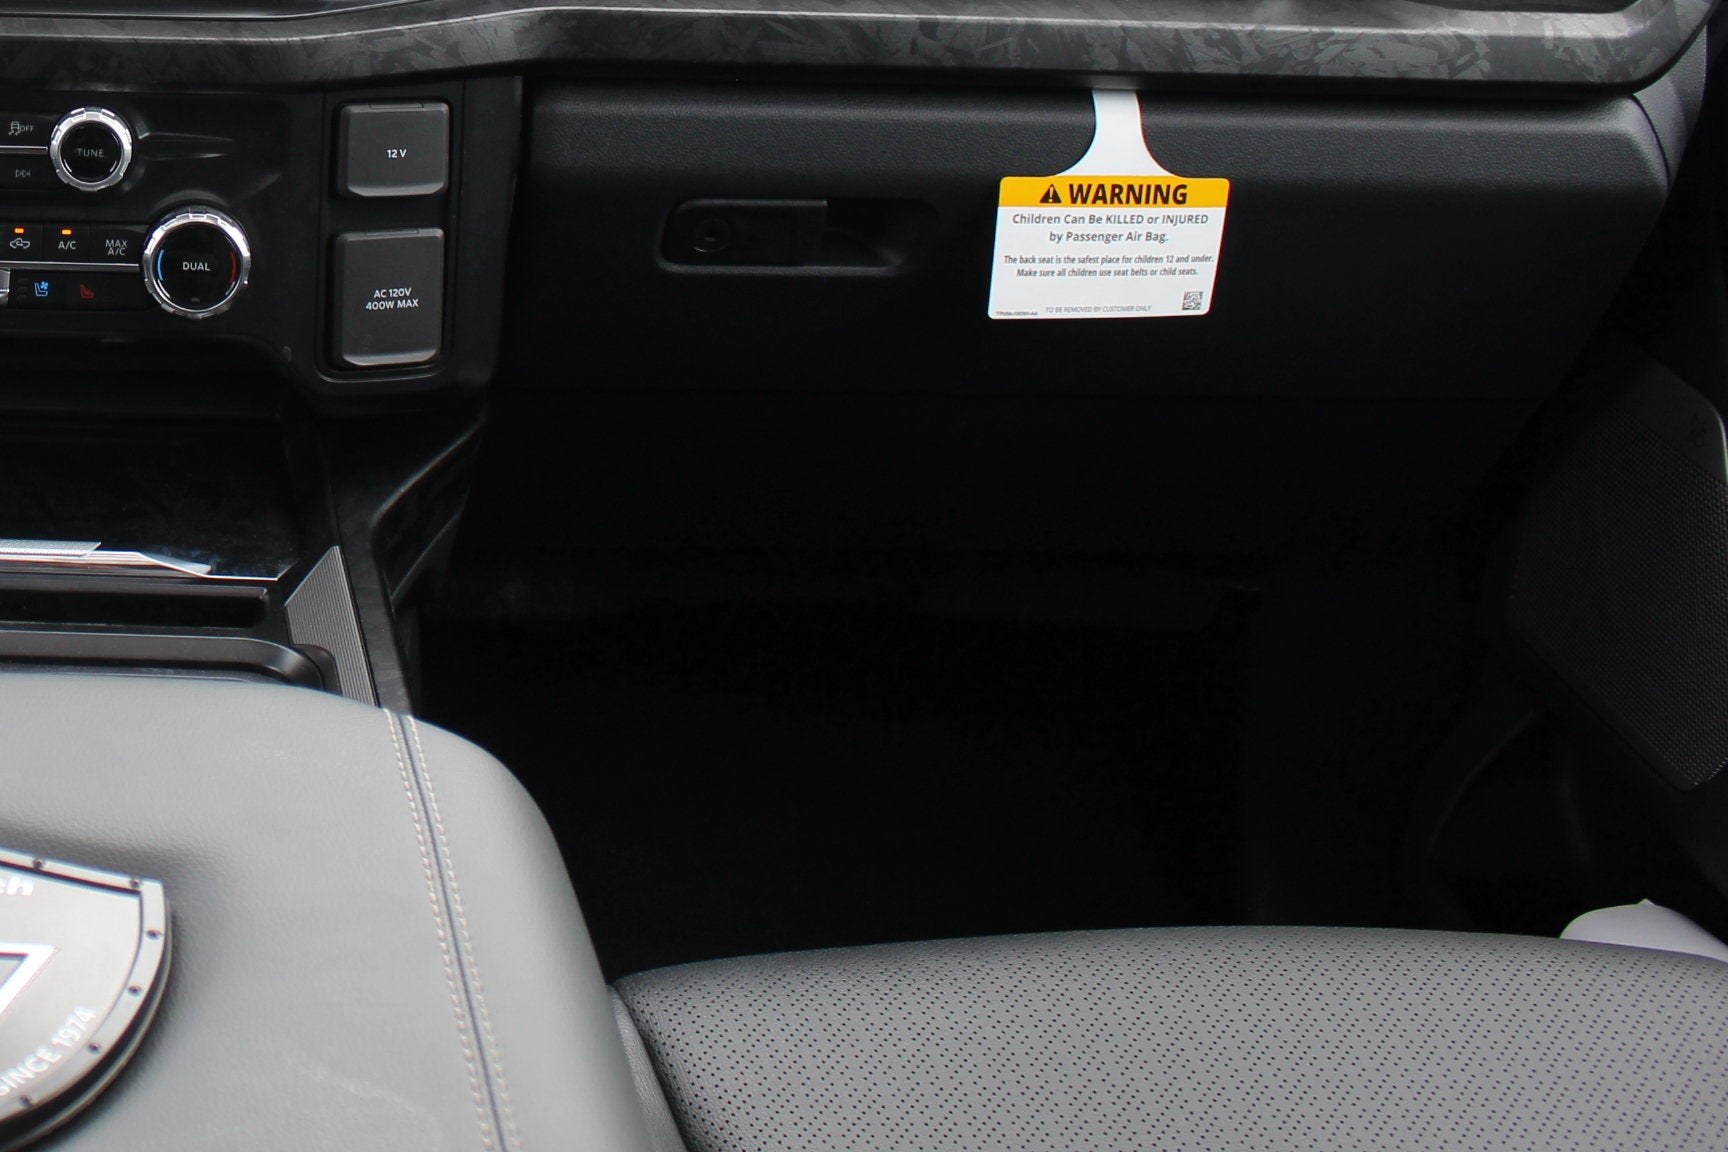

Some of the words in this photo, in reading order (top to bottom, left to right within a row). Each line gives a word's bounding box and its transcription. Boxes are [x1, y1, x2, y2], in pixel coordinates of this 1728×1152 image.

[20, 124, 35, 133] OFF
[77, 148, 105, 158] TUNE
[387, 149, 398, 158] 12
[1069, 184, 1188, 205] WARNING
[1012, 214, 1060, 224] Children
[1063, 214, 1086, 224] Can
[1088, 214, 1103, 224] Be
[1105, 214, 1144, 224] KILLED
[1147, 216, 1159, 224] or
[1162, 214, 1209, 226] INJURED
[1049, 231, 1062, 244] by
[1066, 231, 1123, 244] Passenger
[1126, 231, 1142, 242] Air
[1145, 232, 1169, 244] Bag.
[58, 239, 76, 251] A/C
[105, 239, 128, 249] MAX
[107, 247, 126, 257] A/C
[182, 260, 211, 272] DUAL
[1004, 255, 1017, 264] The
[1019, 255, 1036, 264] back
[1038, 256, 1054, 264] seat
[1055, 256, 1062, 264] is
[1064, 256, 1076, 264] the
[1077, 255, 1099, 264] safest
[1100, 255, 1120, 266] place
[1121, 255, 1132, 264] for
[1133, 255, 1164, 264] children
[1165, 255, 1174, 263] 12
[1175, 255, 1189, 263] and
[1190, 254, 1214, 263] under.
[1017, 269, 1038, 277] Make
[1056, 269, 1066, 277] all
[1068, 268, 1097, 277] children
[1113, 269, 1128, 277] seat
[1130, 268, 1148, 276] belts
[1159, 268, 1177, 276] child
[373, 289, 387, 299] AC
[389, 287, 412, 298] 120V
[365, 300, 395, 311] 400W
[397, 298, 419, 309] MAX
[51, 1006, 96, 1055] 1974
